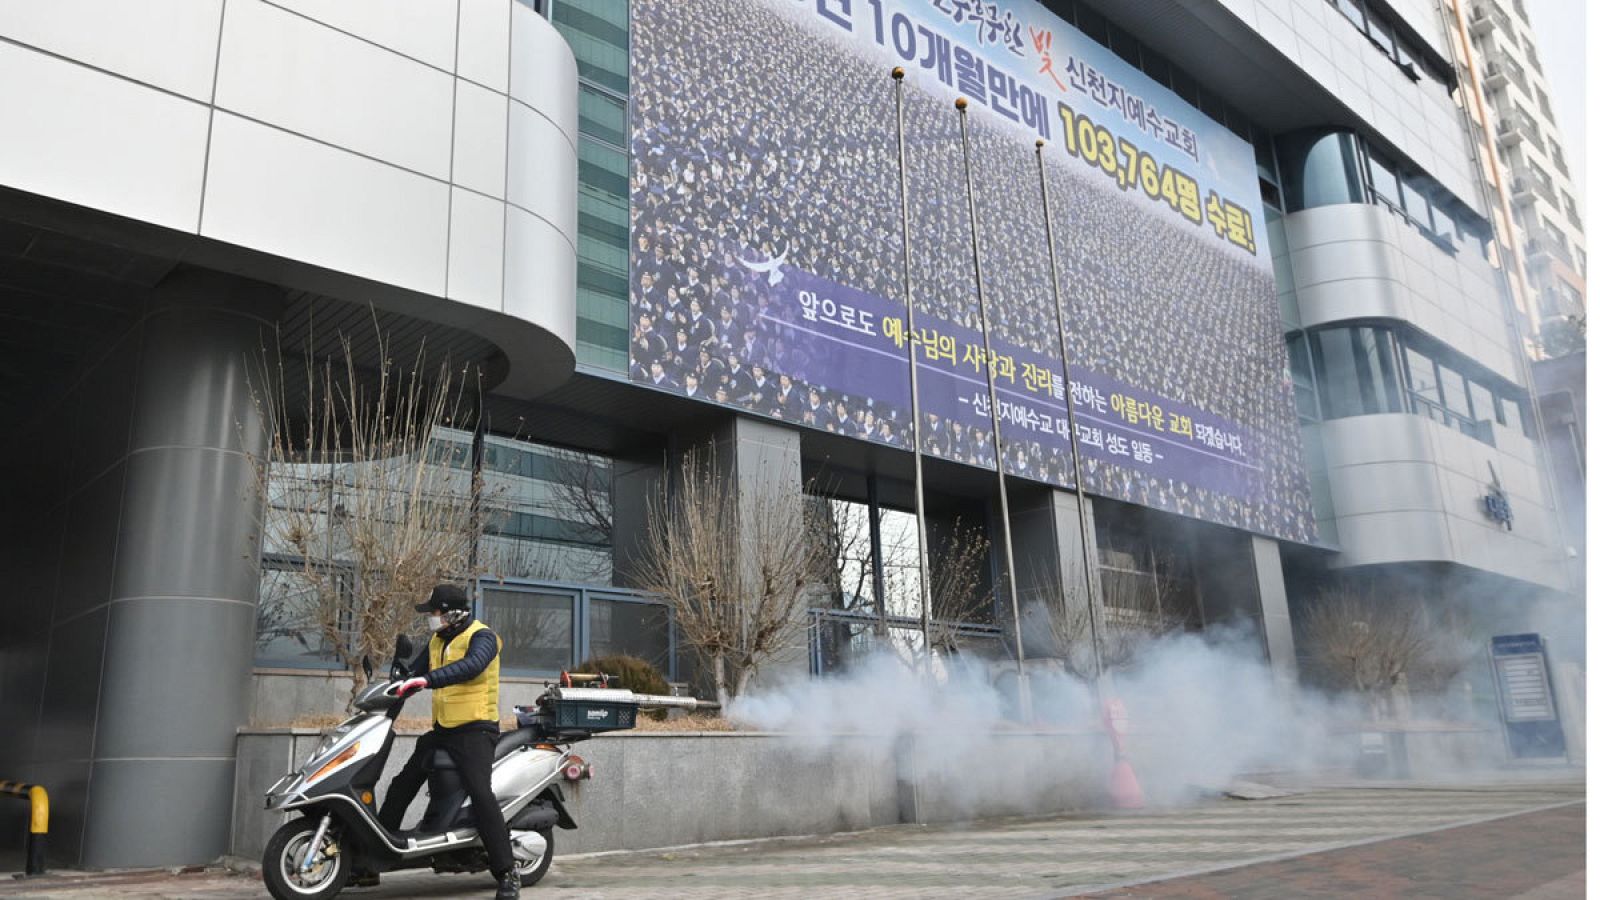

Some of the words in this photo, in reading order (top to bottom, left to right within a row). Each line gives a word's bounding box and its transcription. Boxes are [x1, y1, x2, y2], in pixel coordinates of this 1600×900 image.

[868, 0, 1051, 140] 10개월만에
[1058, 101, 1203, 226] 103,764명
[1206, 189, 1257, 256] 수료!
[1028, 26, 1067, 92] 빛
[1066, 55, 1199, 162] 신천지예수교회
[799, 290, 877, 337] 앞으로도
[882, 316, 957, 366] 예수님의
[962, 343, 1016, 384] 사랑과
[1021, 361, 1066, 401] 진리를
[1068, 380, 1108, 415] 전하는
[1110, 393, 1165, 432] 아름다운
[1168, 412, 1193, 440] 교회
[1106, 433, 1131, 457] 성도
[1132, 439, 1154, 465] 일동
